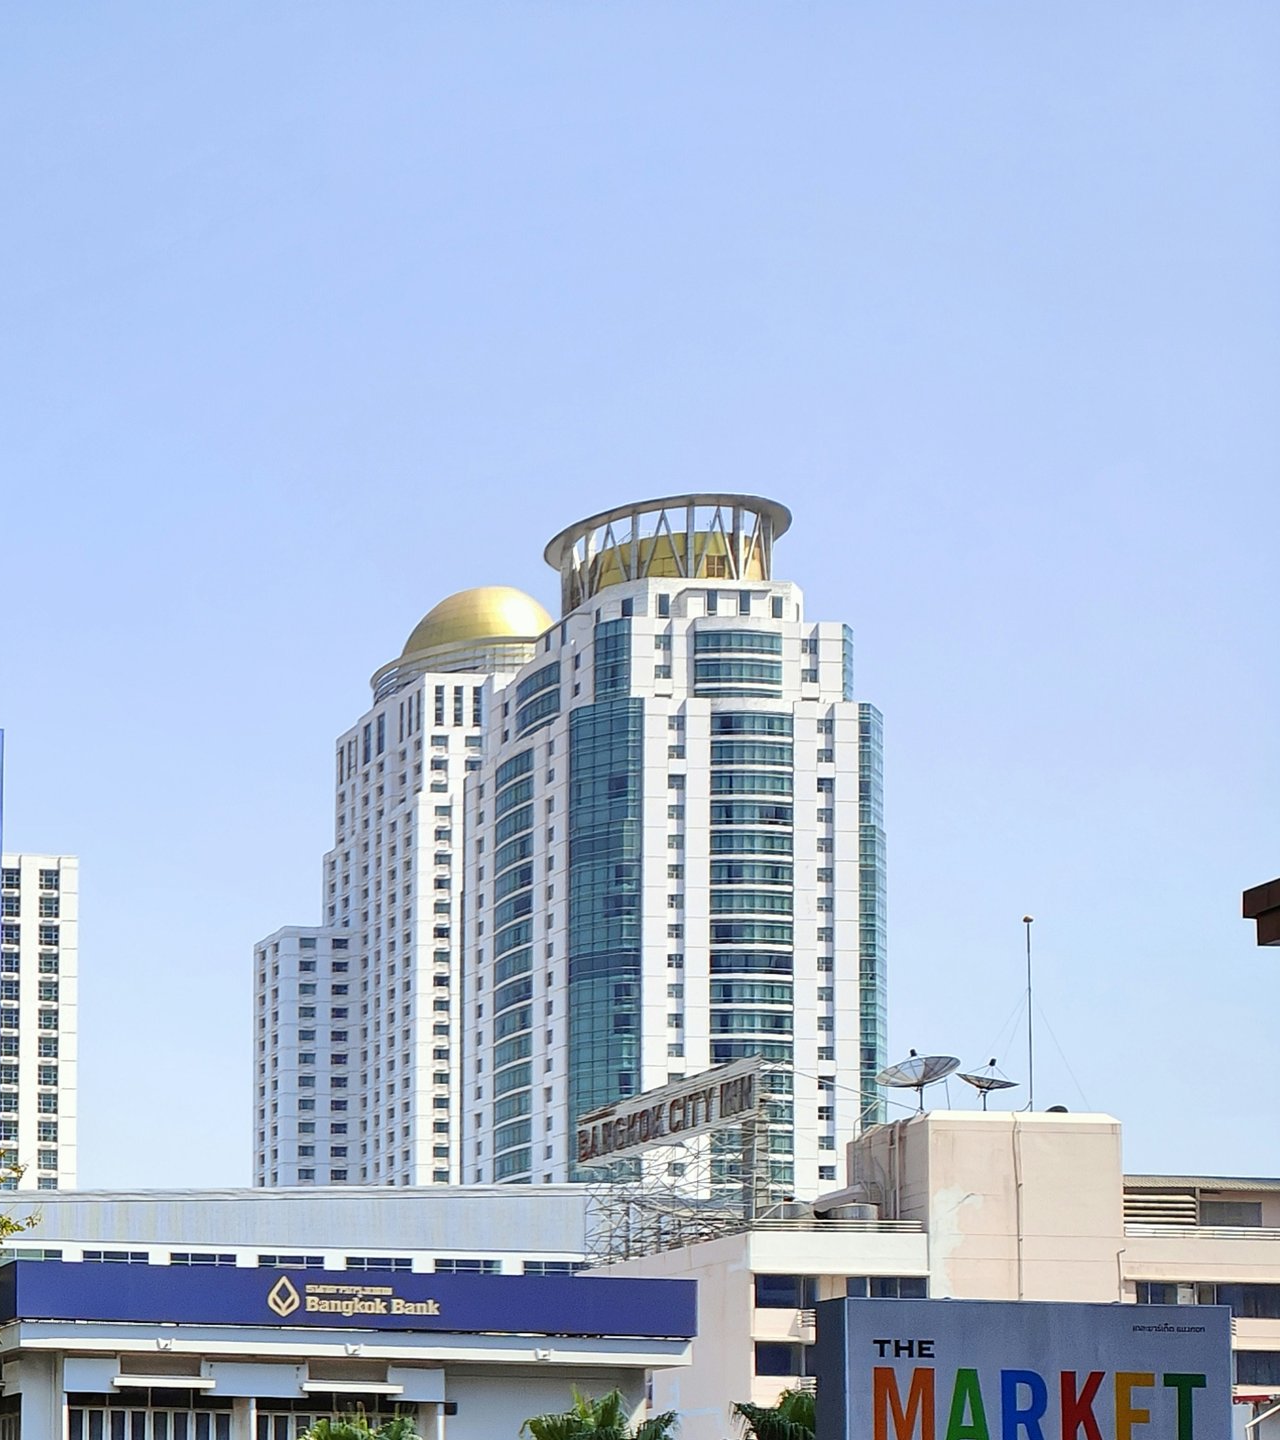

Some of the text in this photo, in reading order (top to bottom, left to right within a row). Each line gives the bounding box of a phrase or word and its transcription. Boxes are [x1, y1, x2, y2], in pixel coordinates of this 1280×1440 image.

[669, 1087, 713, 1132] CITY
[305, 1296, 440, 1316] Bangkok Bank
[873, 1339, 935, 1359] THE
